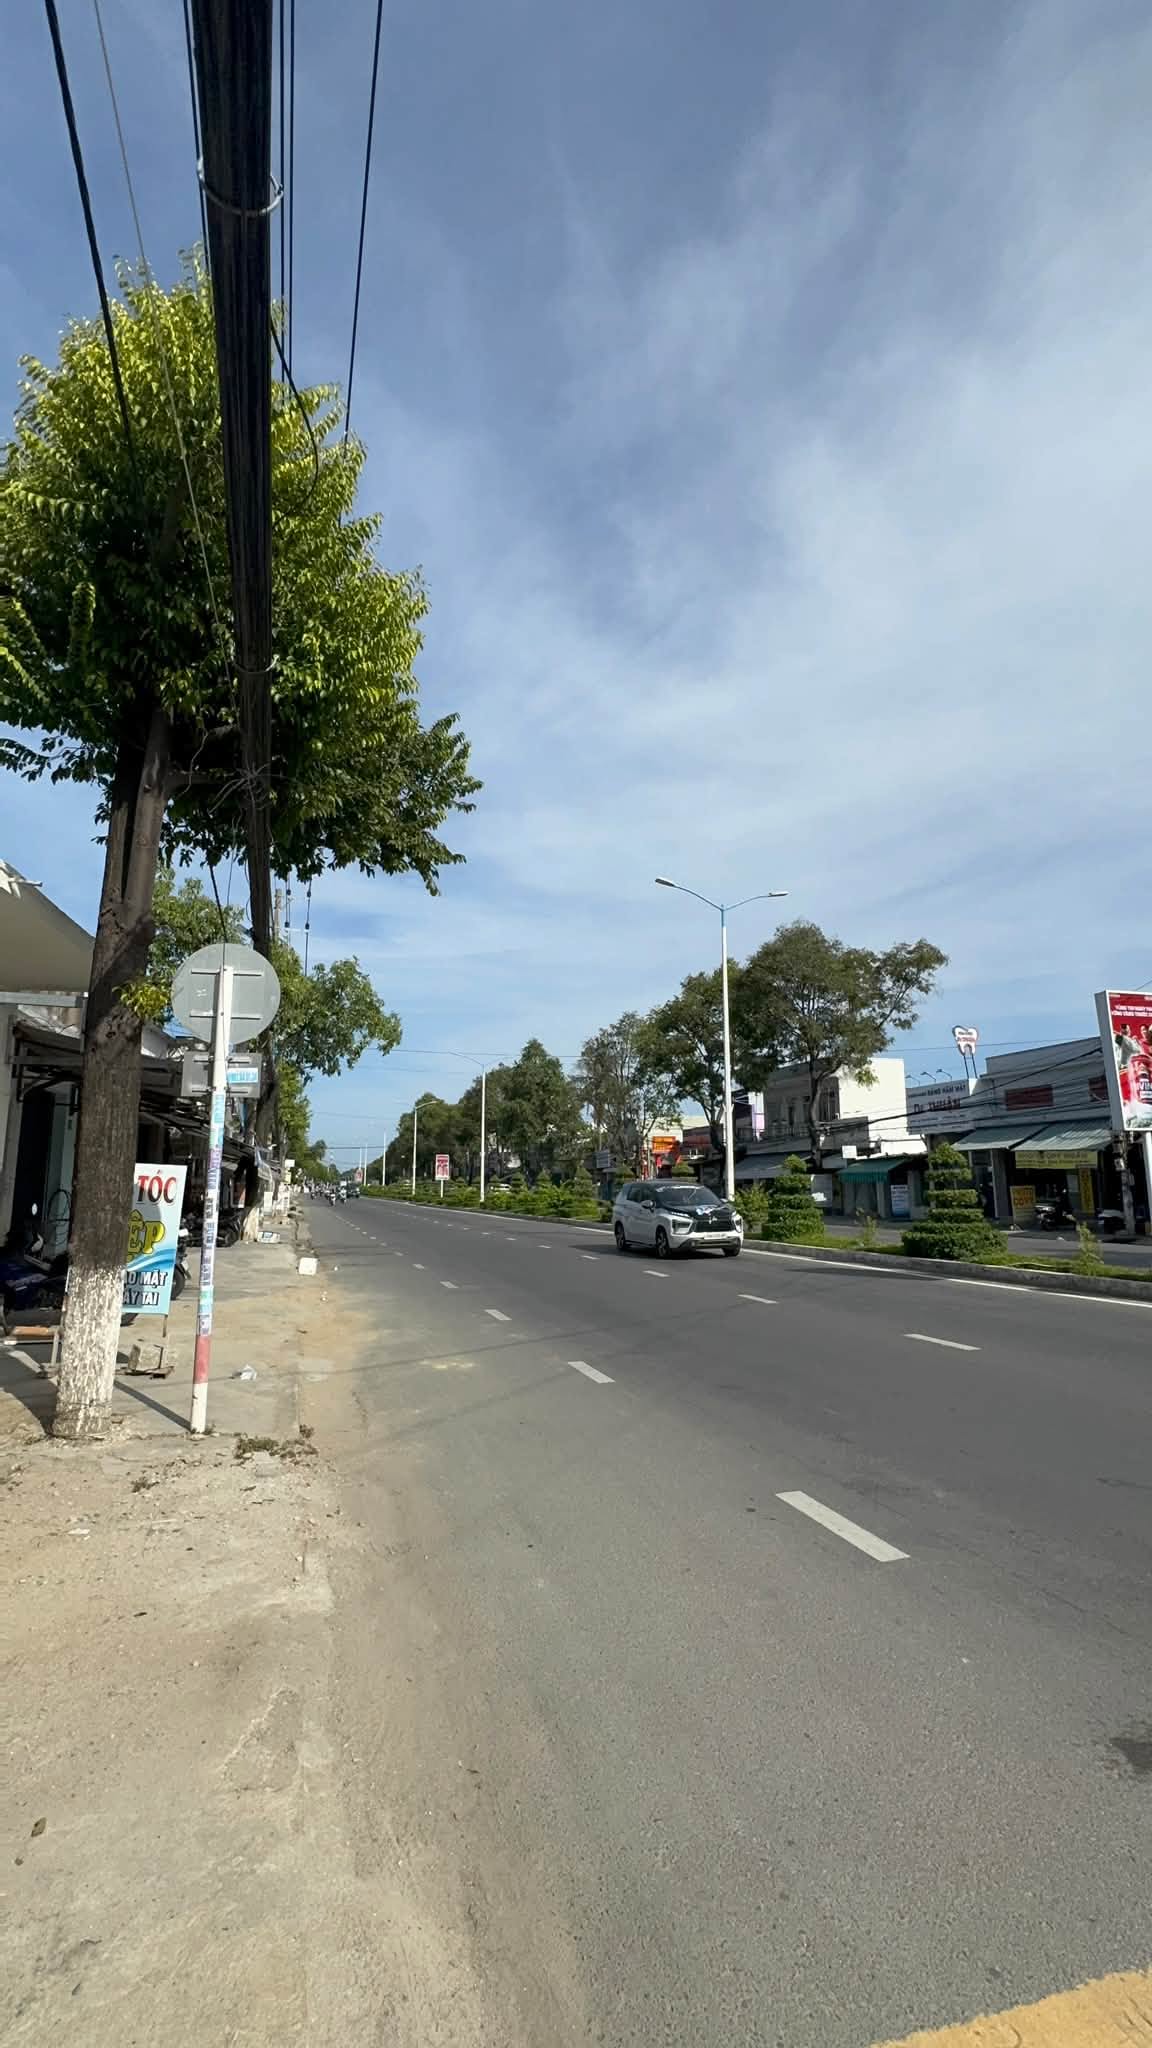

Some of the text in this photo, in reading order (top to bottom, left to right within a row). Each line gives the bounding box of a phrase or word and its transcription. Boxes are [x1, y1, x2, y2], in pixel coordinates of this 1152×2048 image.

[136, 1170, 177, 1204] TÓC
[127, 1209, 165, 1262] ỆP
[139, 1269, 168, 1288] MẶT
[123, 1288, 160, 1305] ÁY TAI
